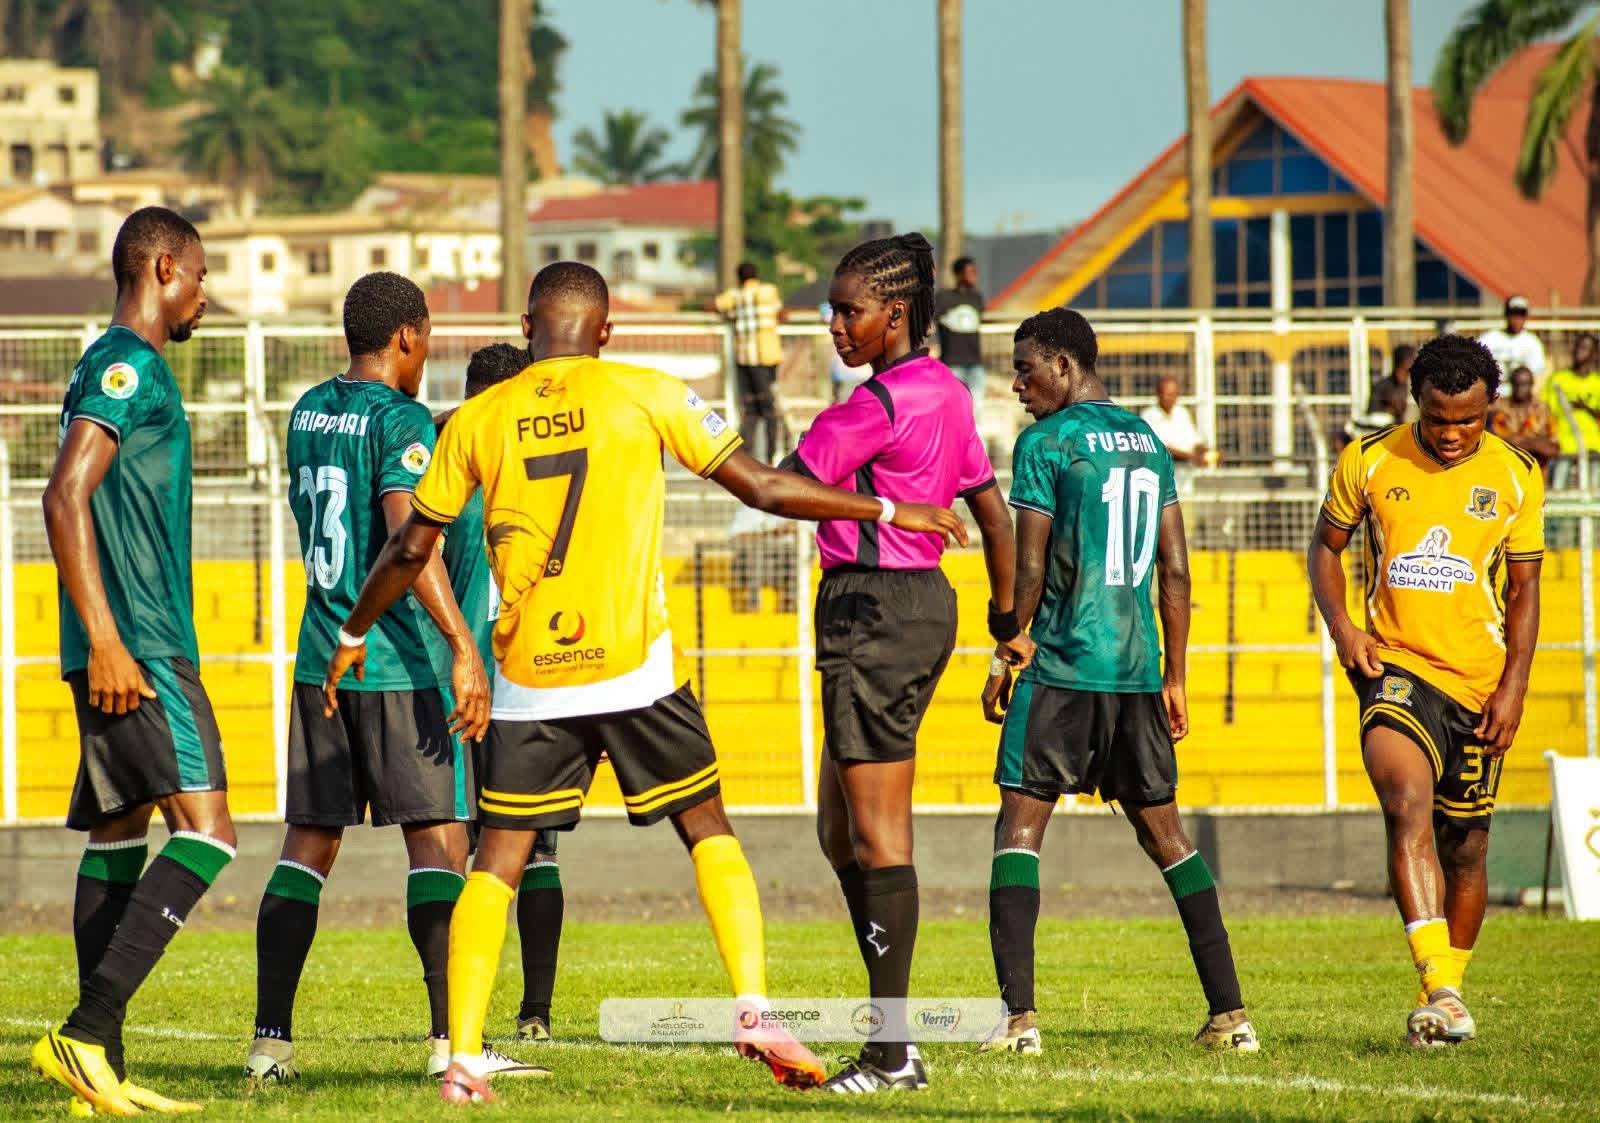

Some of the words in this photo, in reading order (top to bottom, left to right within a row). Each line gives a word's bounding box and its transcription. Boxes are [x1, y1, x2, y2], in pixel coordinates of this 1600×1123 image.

[517, 407, 585, 442] FOSU
[298, 465, 349, 590] 23
[523, 447, 589, 578] 7
[1101, 466, 1161, 588] 10
[1388, 574, 1453, 591] ASHANTI
[533, 647, 606, 667] essence
